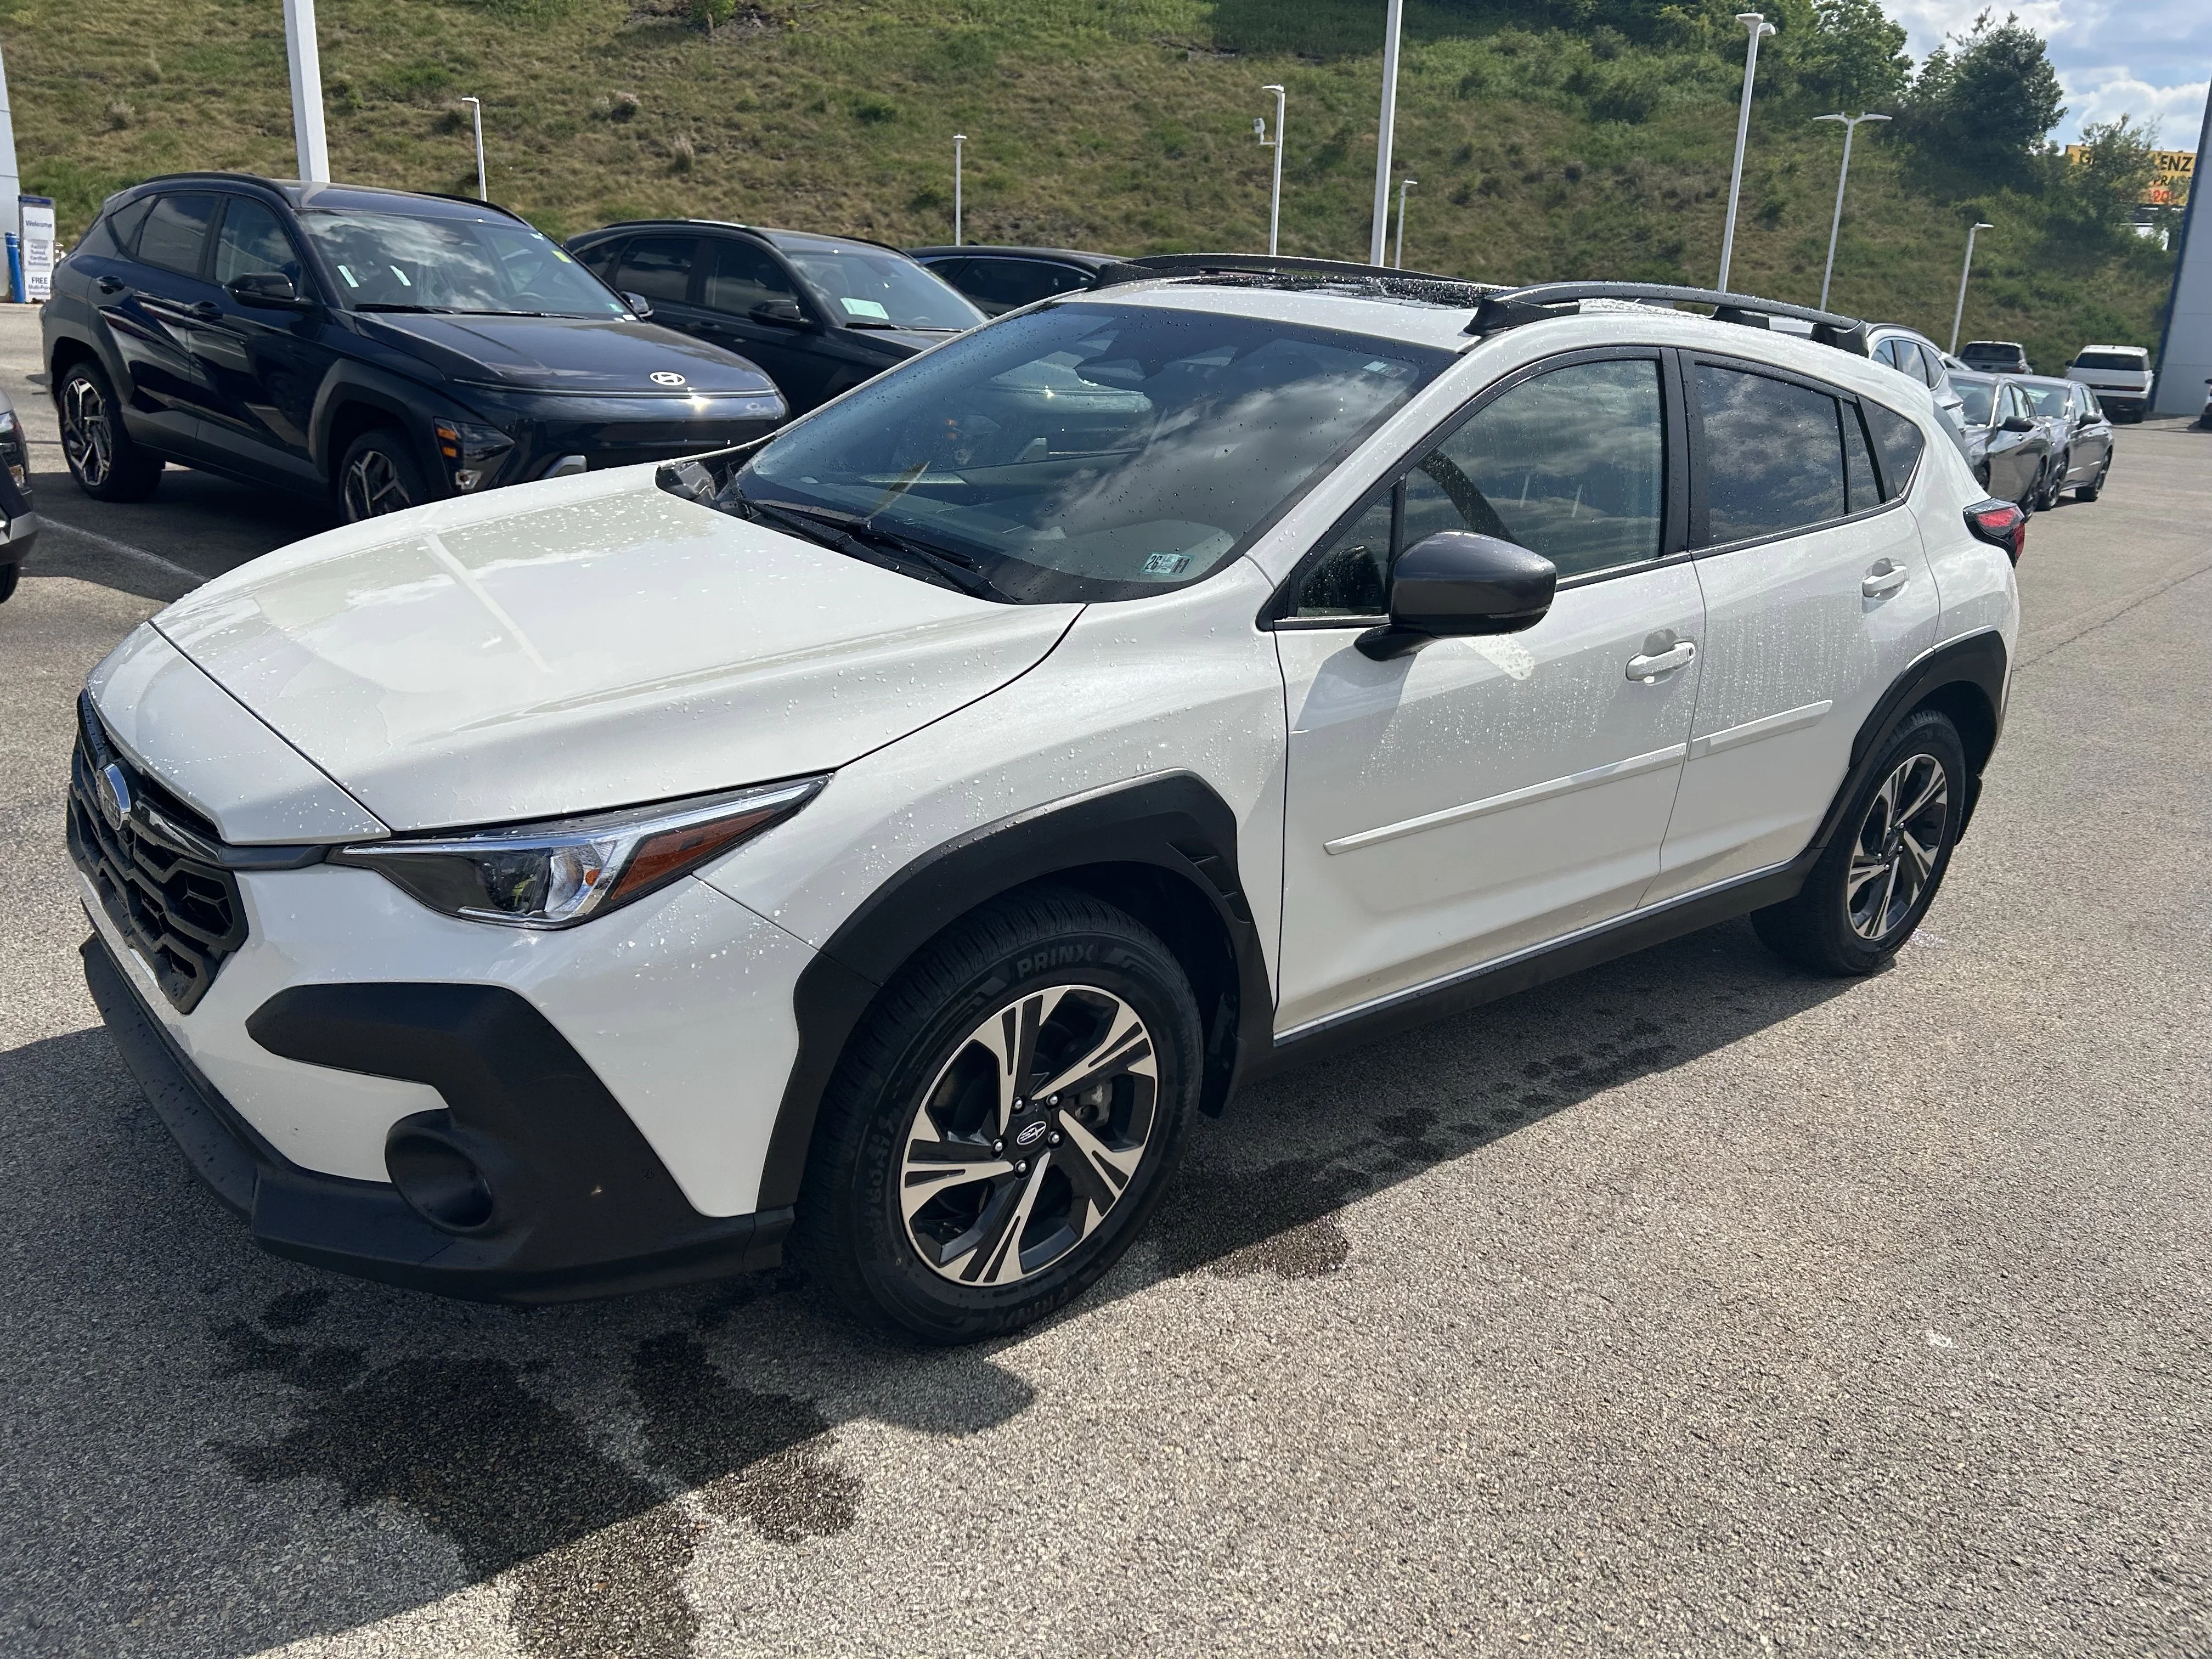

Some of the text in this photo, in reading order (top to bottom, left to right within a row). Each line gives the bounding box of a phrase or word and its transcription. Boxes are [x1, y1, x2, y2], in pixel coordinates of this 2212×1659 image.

[25, 219, 52, 228] Welcome
[31, 276, 48, 285] FREE
[1145, 555, 1163, 571] 26
[1017, 944, 1094, 979] PRINX
